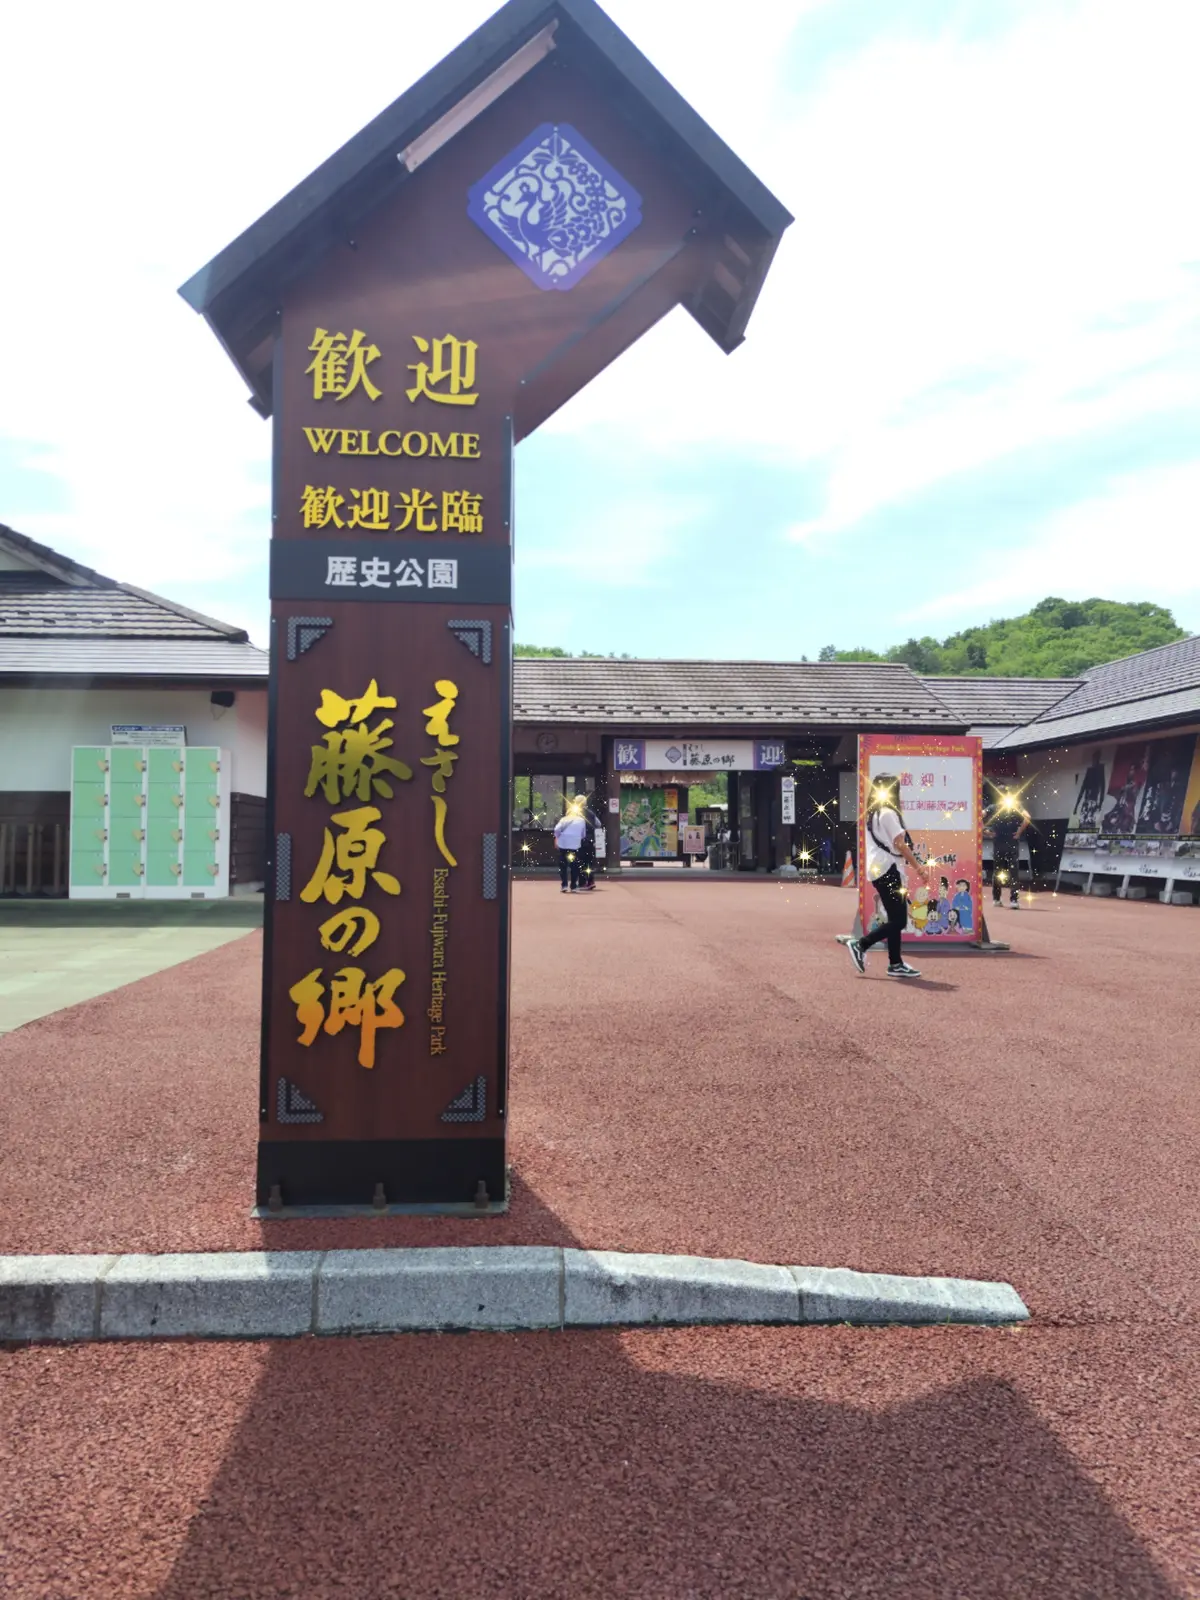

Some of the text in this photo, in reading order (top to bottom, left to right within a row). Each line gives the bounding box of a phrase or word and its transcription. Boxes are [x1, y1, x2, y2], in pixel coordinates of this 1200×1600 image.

[303, 427, 481, 458] WELCOME
[299, 484, 484, 533] 歓迎光臨
[325, 556, 459, 589] 歴史公園
[419, 678, 459, 867] えさし
[617, 744, 638, 766] 歓
[760, 745, 783, 766] 迎
[288, 678, 413, 1069] 藤原の郷
[427, 868, 449, 1056] Esashi-Fujiwara Heritage Park
